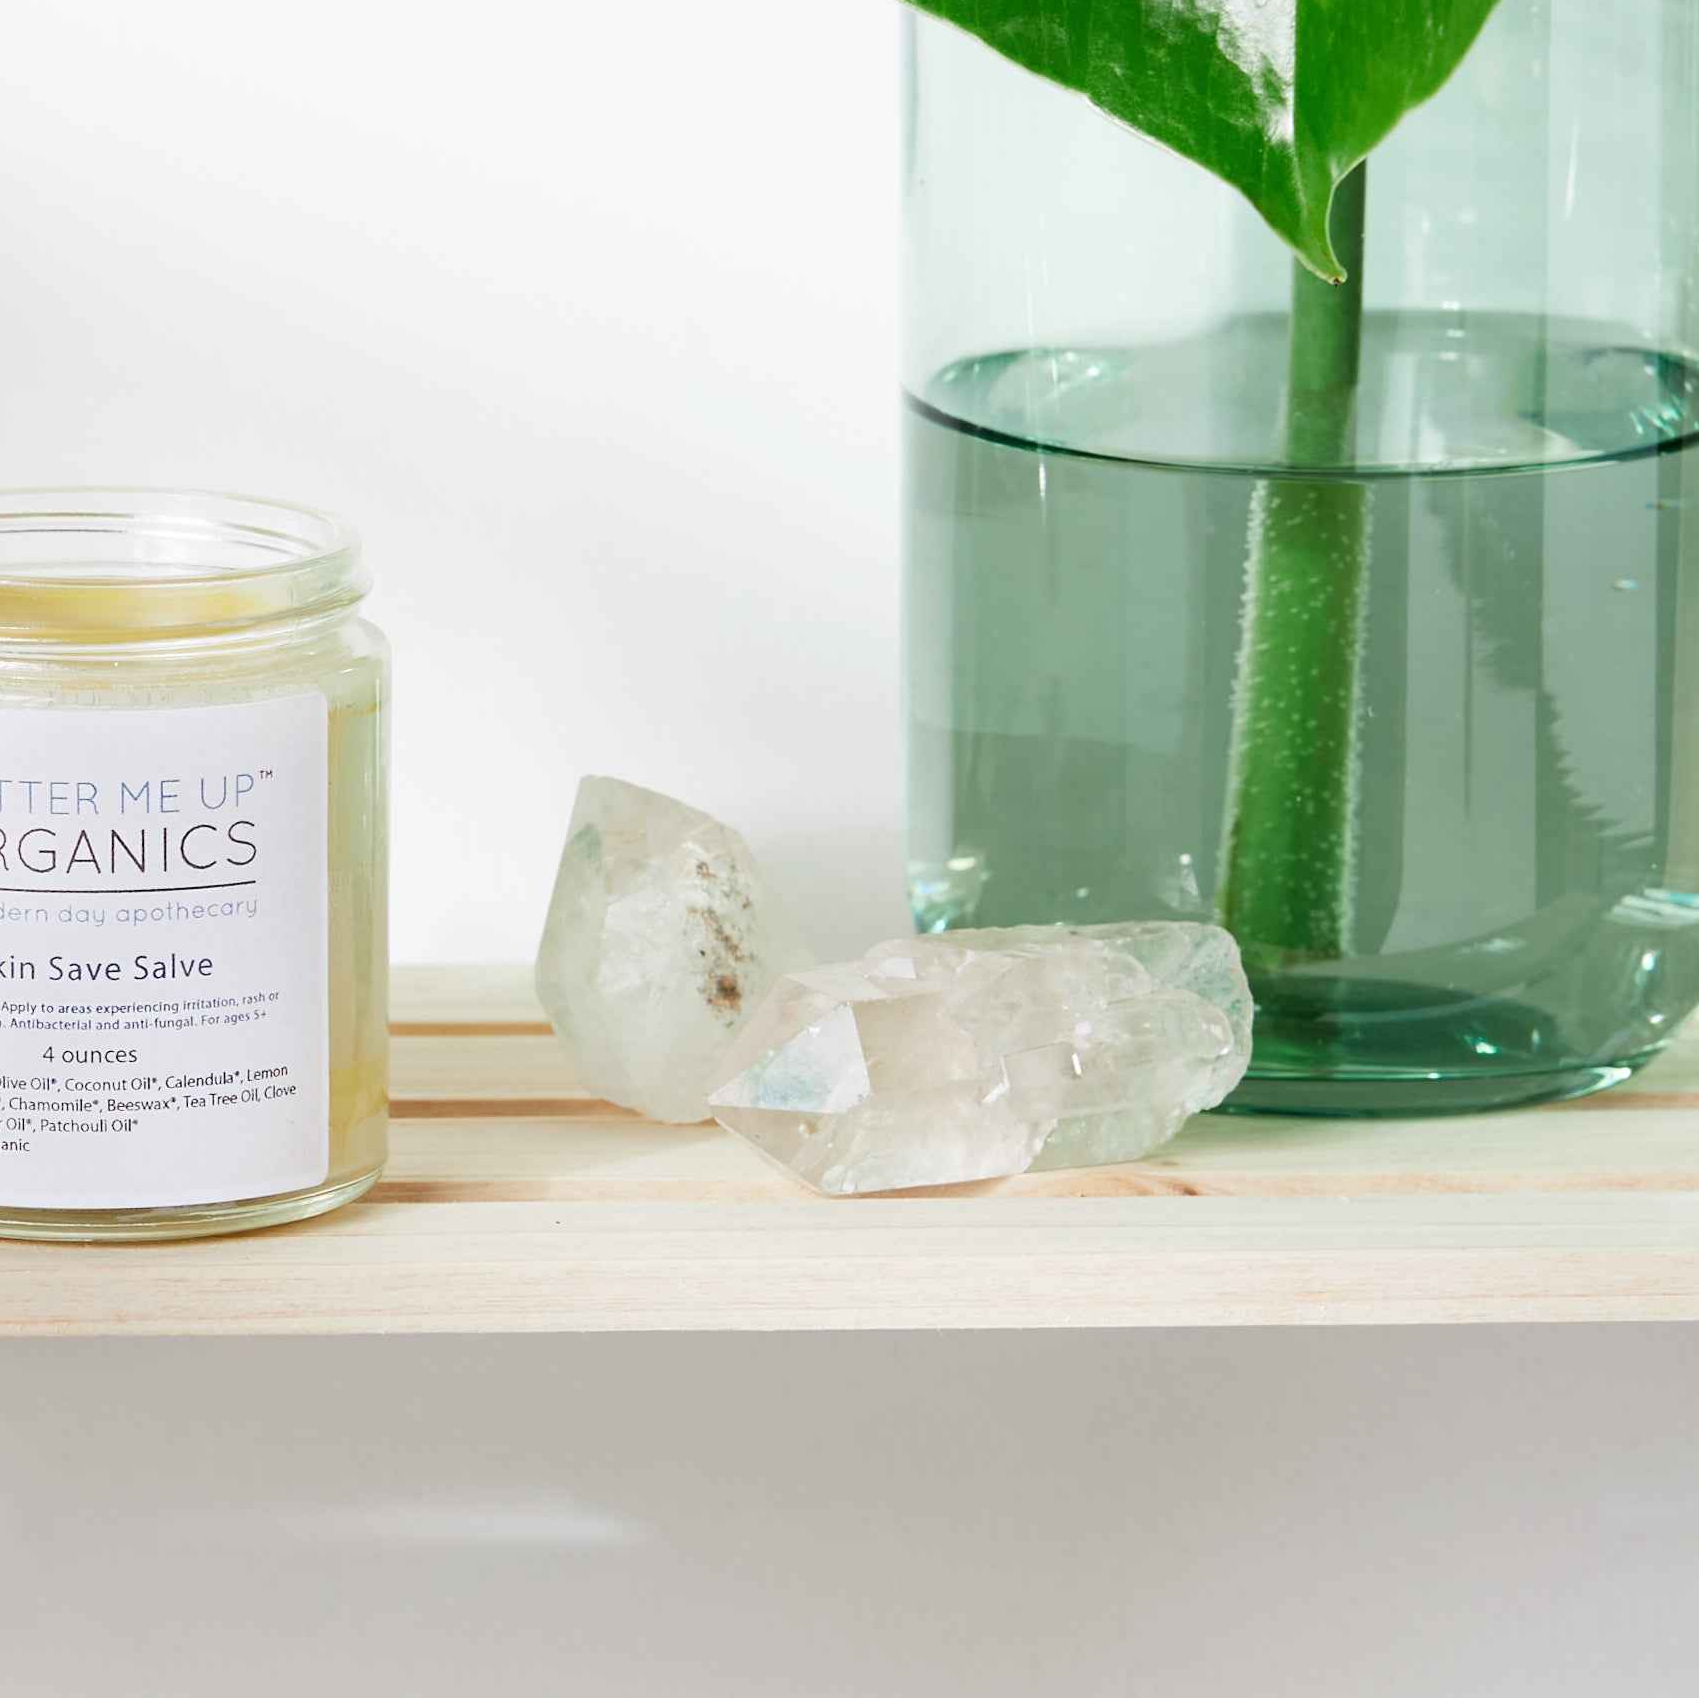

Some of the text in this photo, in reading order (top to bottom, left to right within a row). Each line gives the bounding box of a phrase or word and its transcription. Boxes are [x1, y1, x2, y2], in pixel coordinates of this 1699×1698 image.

[120, 779, 181, 814] ME
[58, 904, 105, 927] day
[116, 896, 258, 927] apothecary
[48, 956, 122, 981] Save
[134, 953, 214, 980] Salve
[1, 1001, 37, 1015] Apply
[41, 1003, 54, 1014] to
[58, 1004, 92, 1014] areas
[95, 1001, 179, 1017] experiencing
[182, 997, 239, 1011] irritation,
[242, 992, 266, 1005] rash
[10, 1017, 92, 1031] Antibacterial
[95, 1019, 120, 1030] and
[123, 1015, 198, 1031] anti-fungal.
[201, 1014, 220, 1026] For
[223, 1012, 250, 1026] ages
[42, 1046, 138, 1063] 4 ounces
[64, 1077, 128, 1091] Coconut
[246, 1065, 288, 1082] Lemon
[183, 1094, 206, 1108] Tea
[210, 1092, 238, 1105] Tree
[264, 1084, 296, 1100] Clove
[40, 1117, 108, 1133] Patchouli
